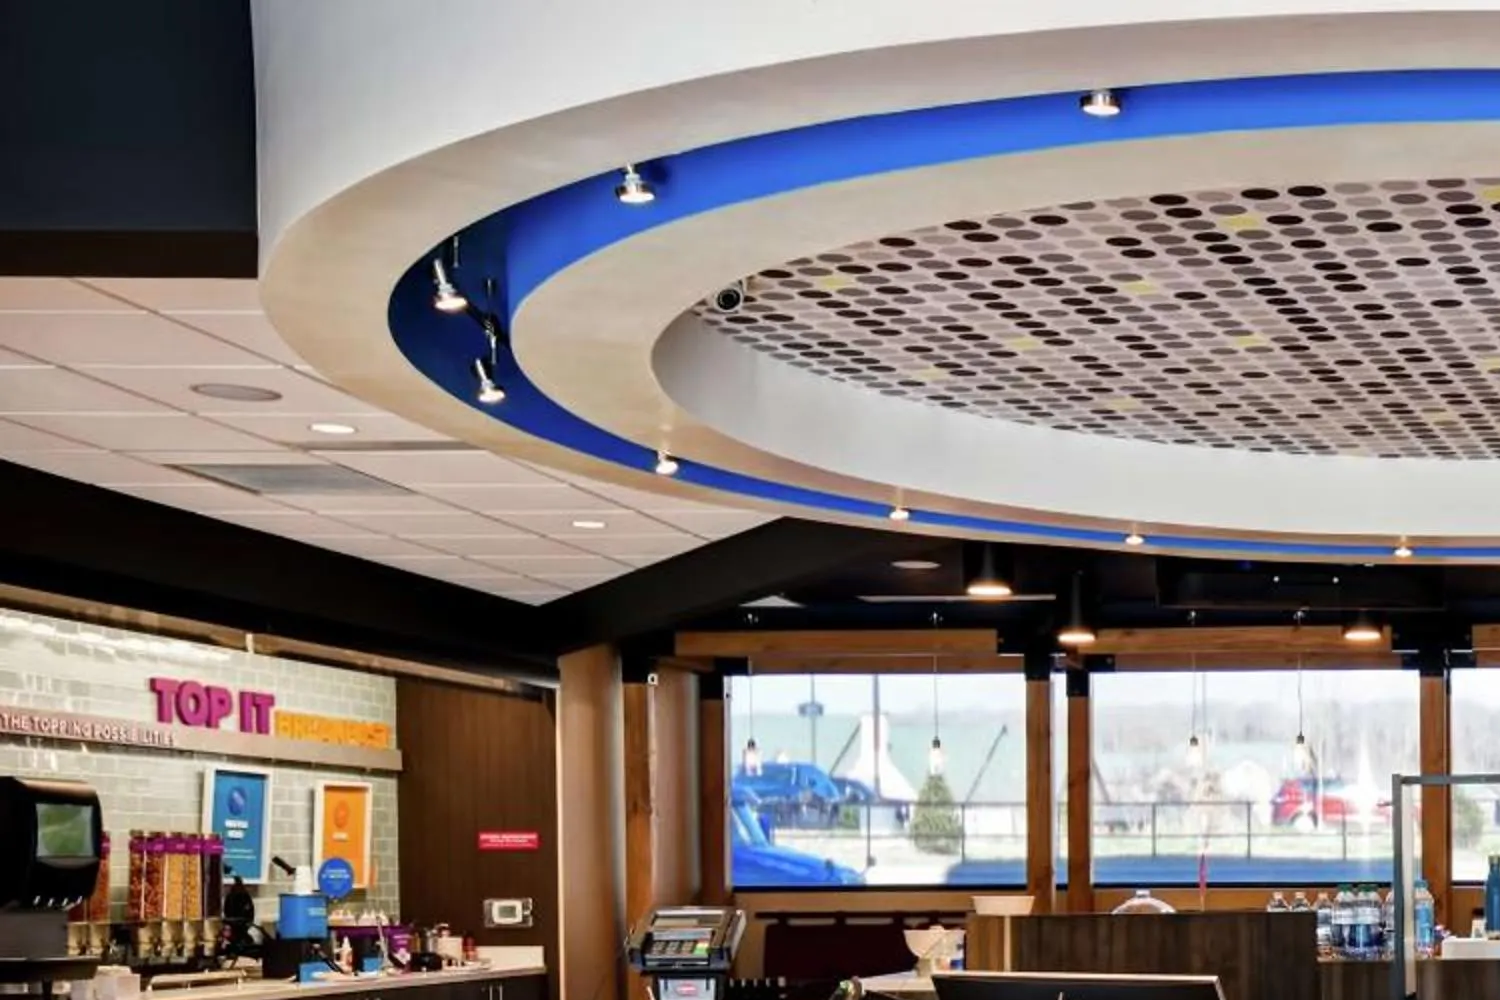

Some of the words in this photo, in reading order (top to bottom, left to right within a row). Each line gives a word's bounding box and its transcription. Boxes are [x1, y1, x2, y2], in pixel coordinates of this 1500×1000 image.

[1, 712, 29, 731] THE
[33, 716, 91, 736] TOPPING
[94, 722, 178, 746] POSSIBILITIES
[150, 677, 233, 729] TOP
[239, 691, 275, 735] IT
